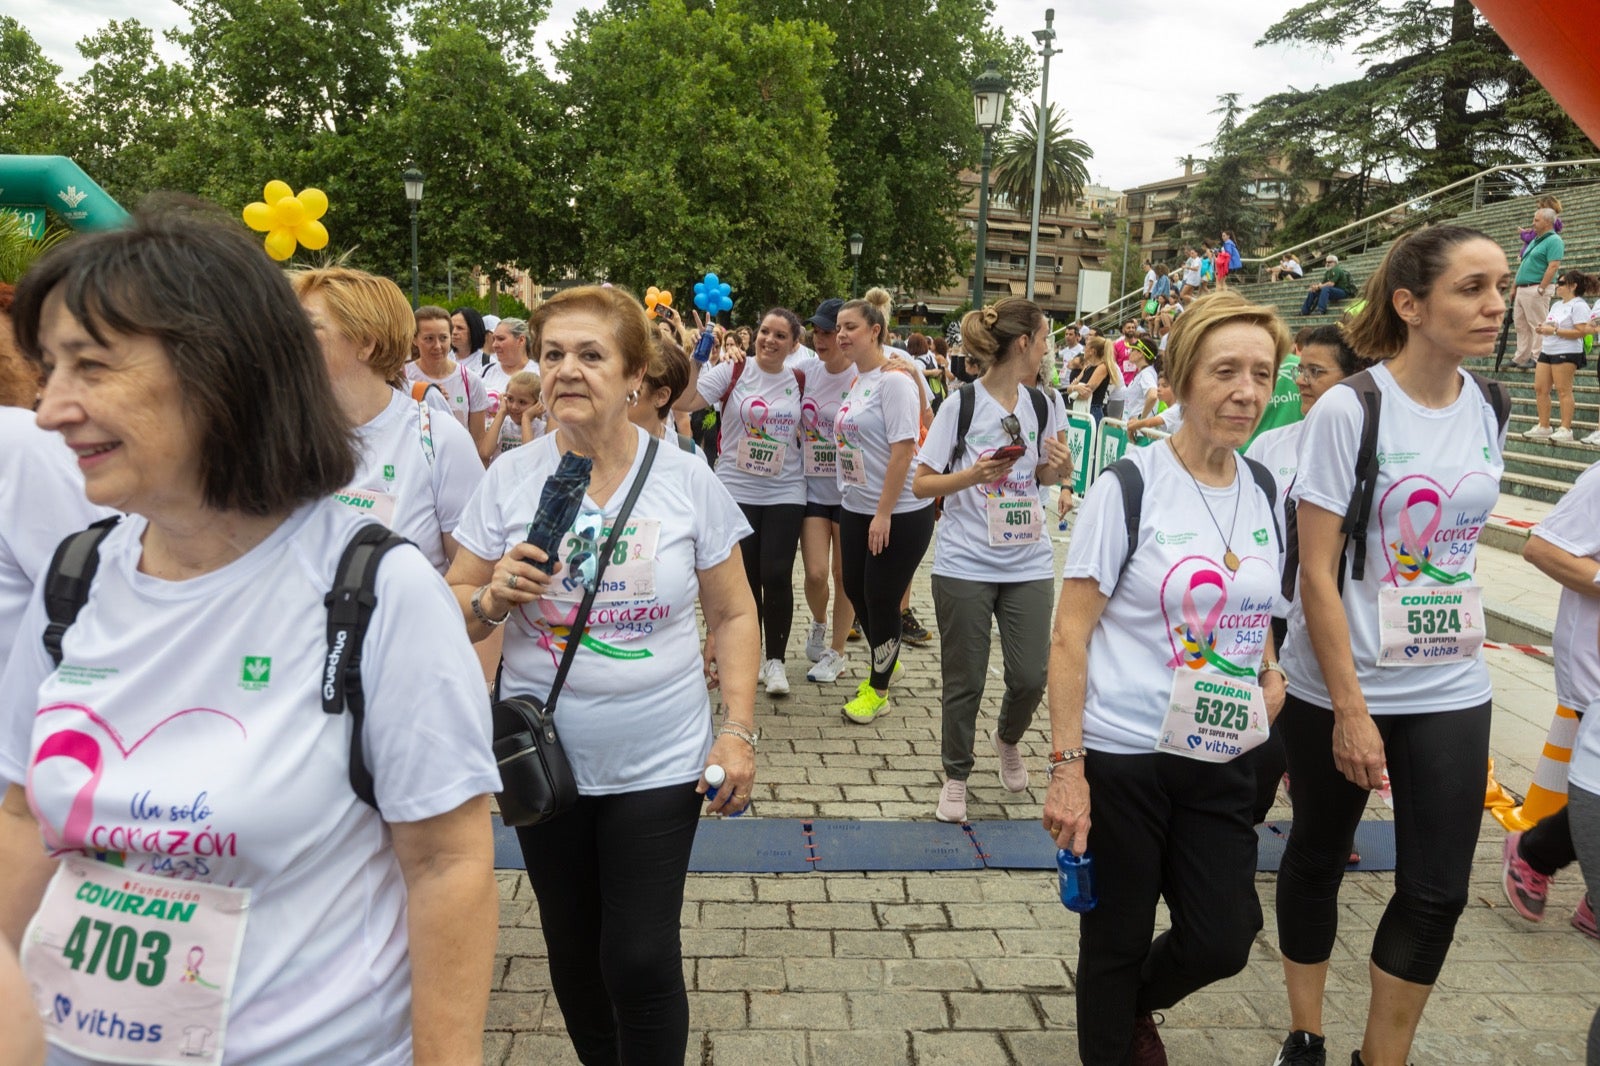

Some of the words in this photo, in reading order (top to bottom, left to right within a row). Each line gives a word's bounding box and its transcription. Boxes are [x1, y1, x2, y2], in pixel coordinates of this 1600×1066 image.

[749, 447, 774, 462] 3877
[814, 451, 836, 462] 390
[1449, 542, 1473, 556] 541
[1240, 597, 1255, 611] Un
[1400, 594, 1463, 606] COVIRAN
[587, 603, 671, 625] corazón
[1407, 608, 1462, 635] 5324
[1235, 630, 1263, 644] 5415
[1423, 646, 1460, 657] vithas
[1194, 680, 1252, 701] COVIRAN
[1194, 697, 1249, 732] 5325
[1205, 740, 1242, 756] vithas
[130, 789, 164, 821] Un
[170, 791, 213, 823] solo
[92, 825, 238, 858] corazón
[75, 880, 199, 923] COVIRAN
[131, 881, 201, 902] Fundación
[62, 914, 172, 988] 4703
[76, 1008, 164, 1043] vithas
